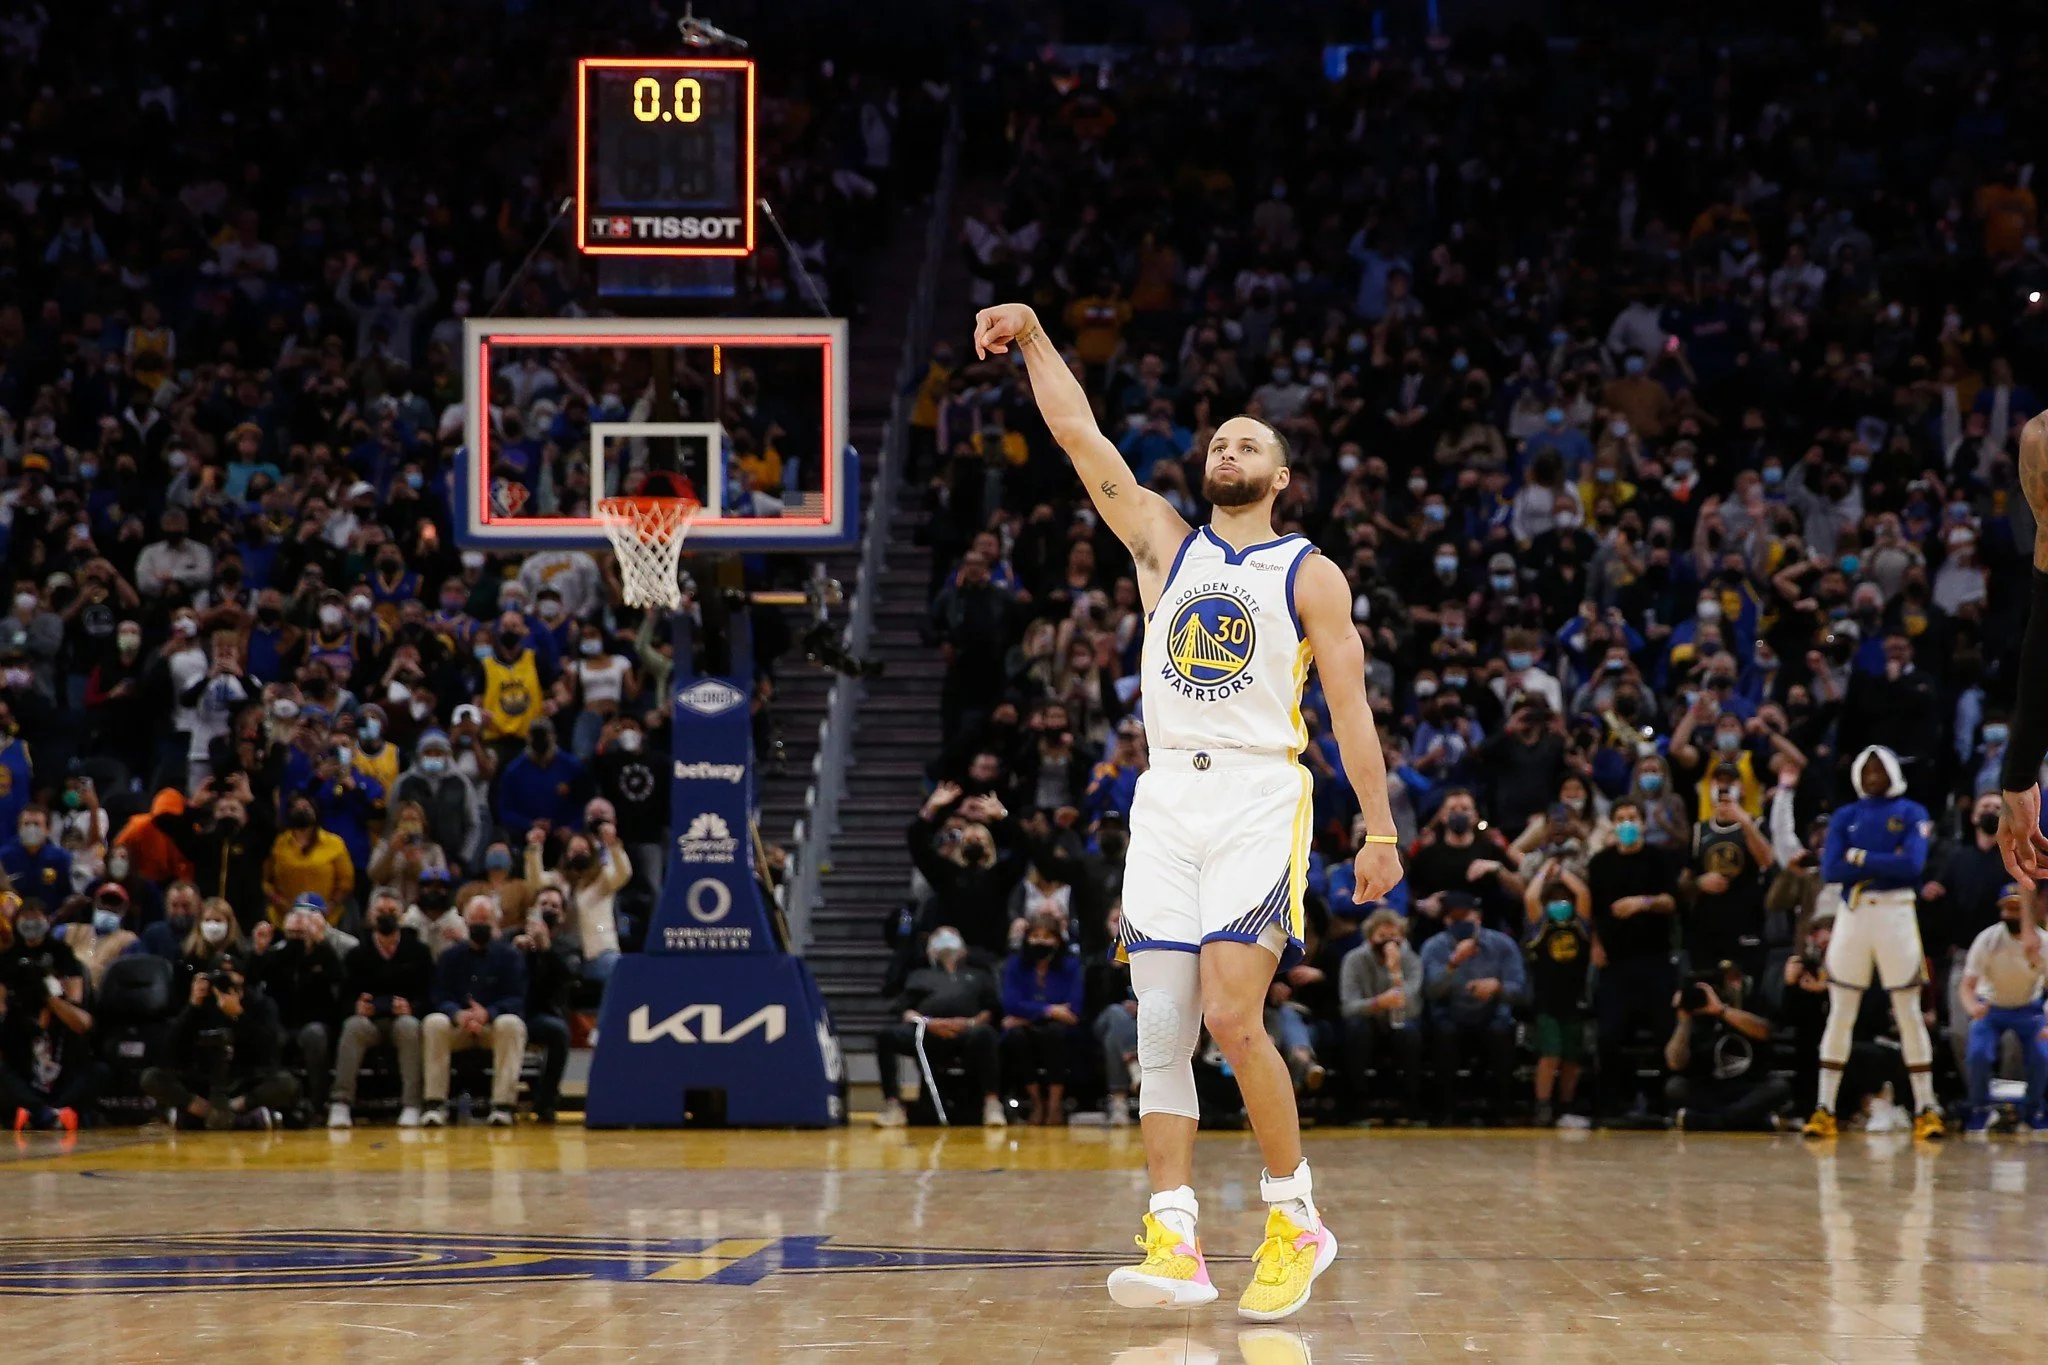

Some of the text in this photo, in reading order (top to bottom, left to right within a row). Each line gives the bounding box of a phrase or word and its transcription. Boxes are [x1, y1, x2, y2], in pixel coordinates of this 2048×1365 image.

[633, 77, 701, 123] 0.0
[632, 217, 742, 239] TISSOT
[1250, 560, 1285, 572] Rakuten
[1175, 582, 1261, 615] GOLDEN STATE
[1214, 615, 1248, 645] 30
[1161, 662, 1254, 702] WARRIORS
[674, 760, 745, 784] betway
[665, 938, 750, 949] PARTNERS
[628, 1003, 787, 1043] KIA
